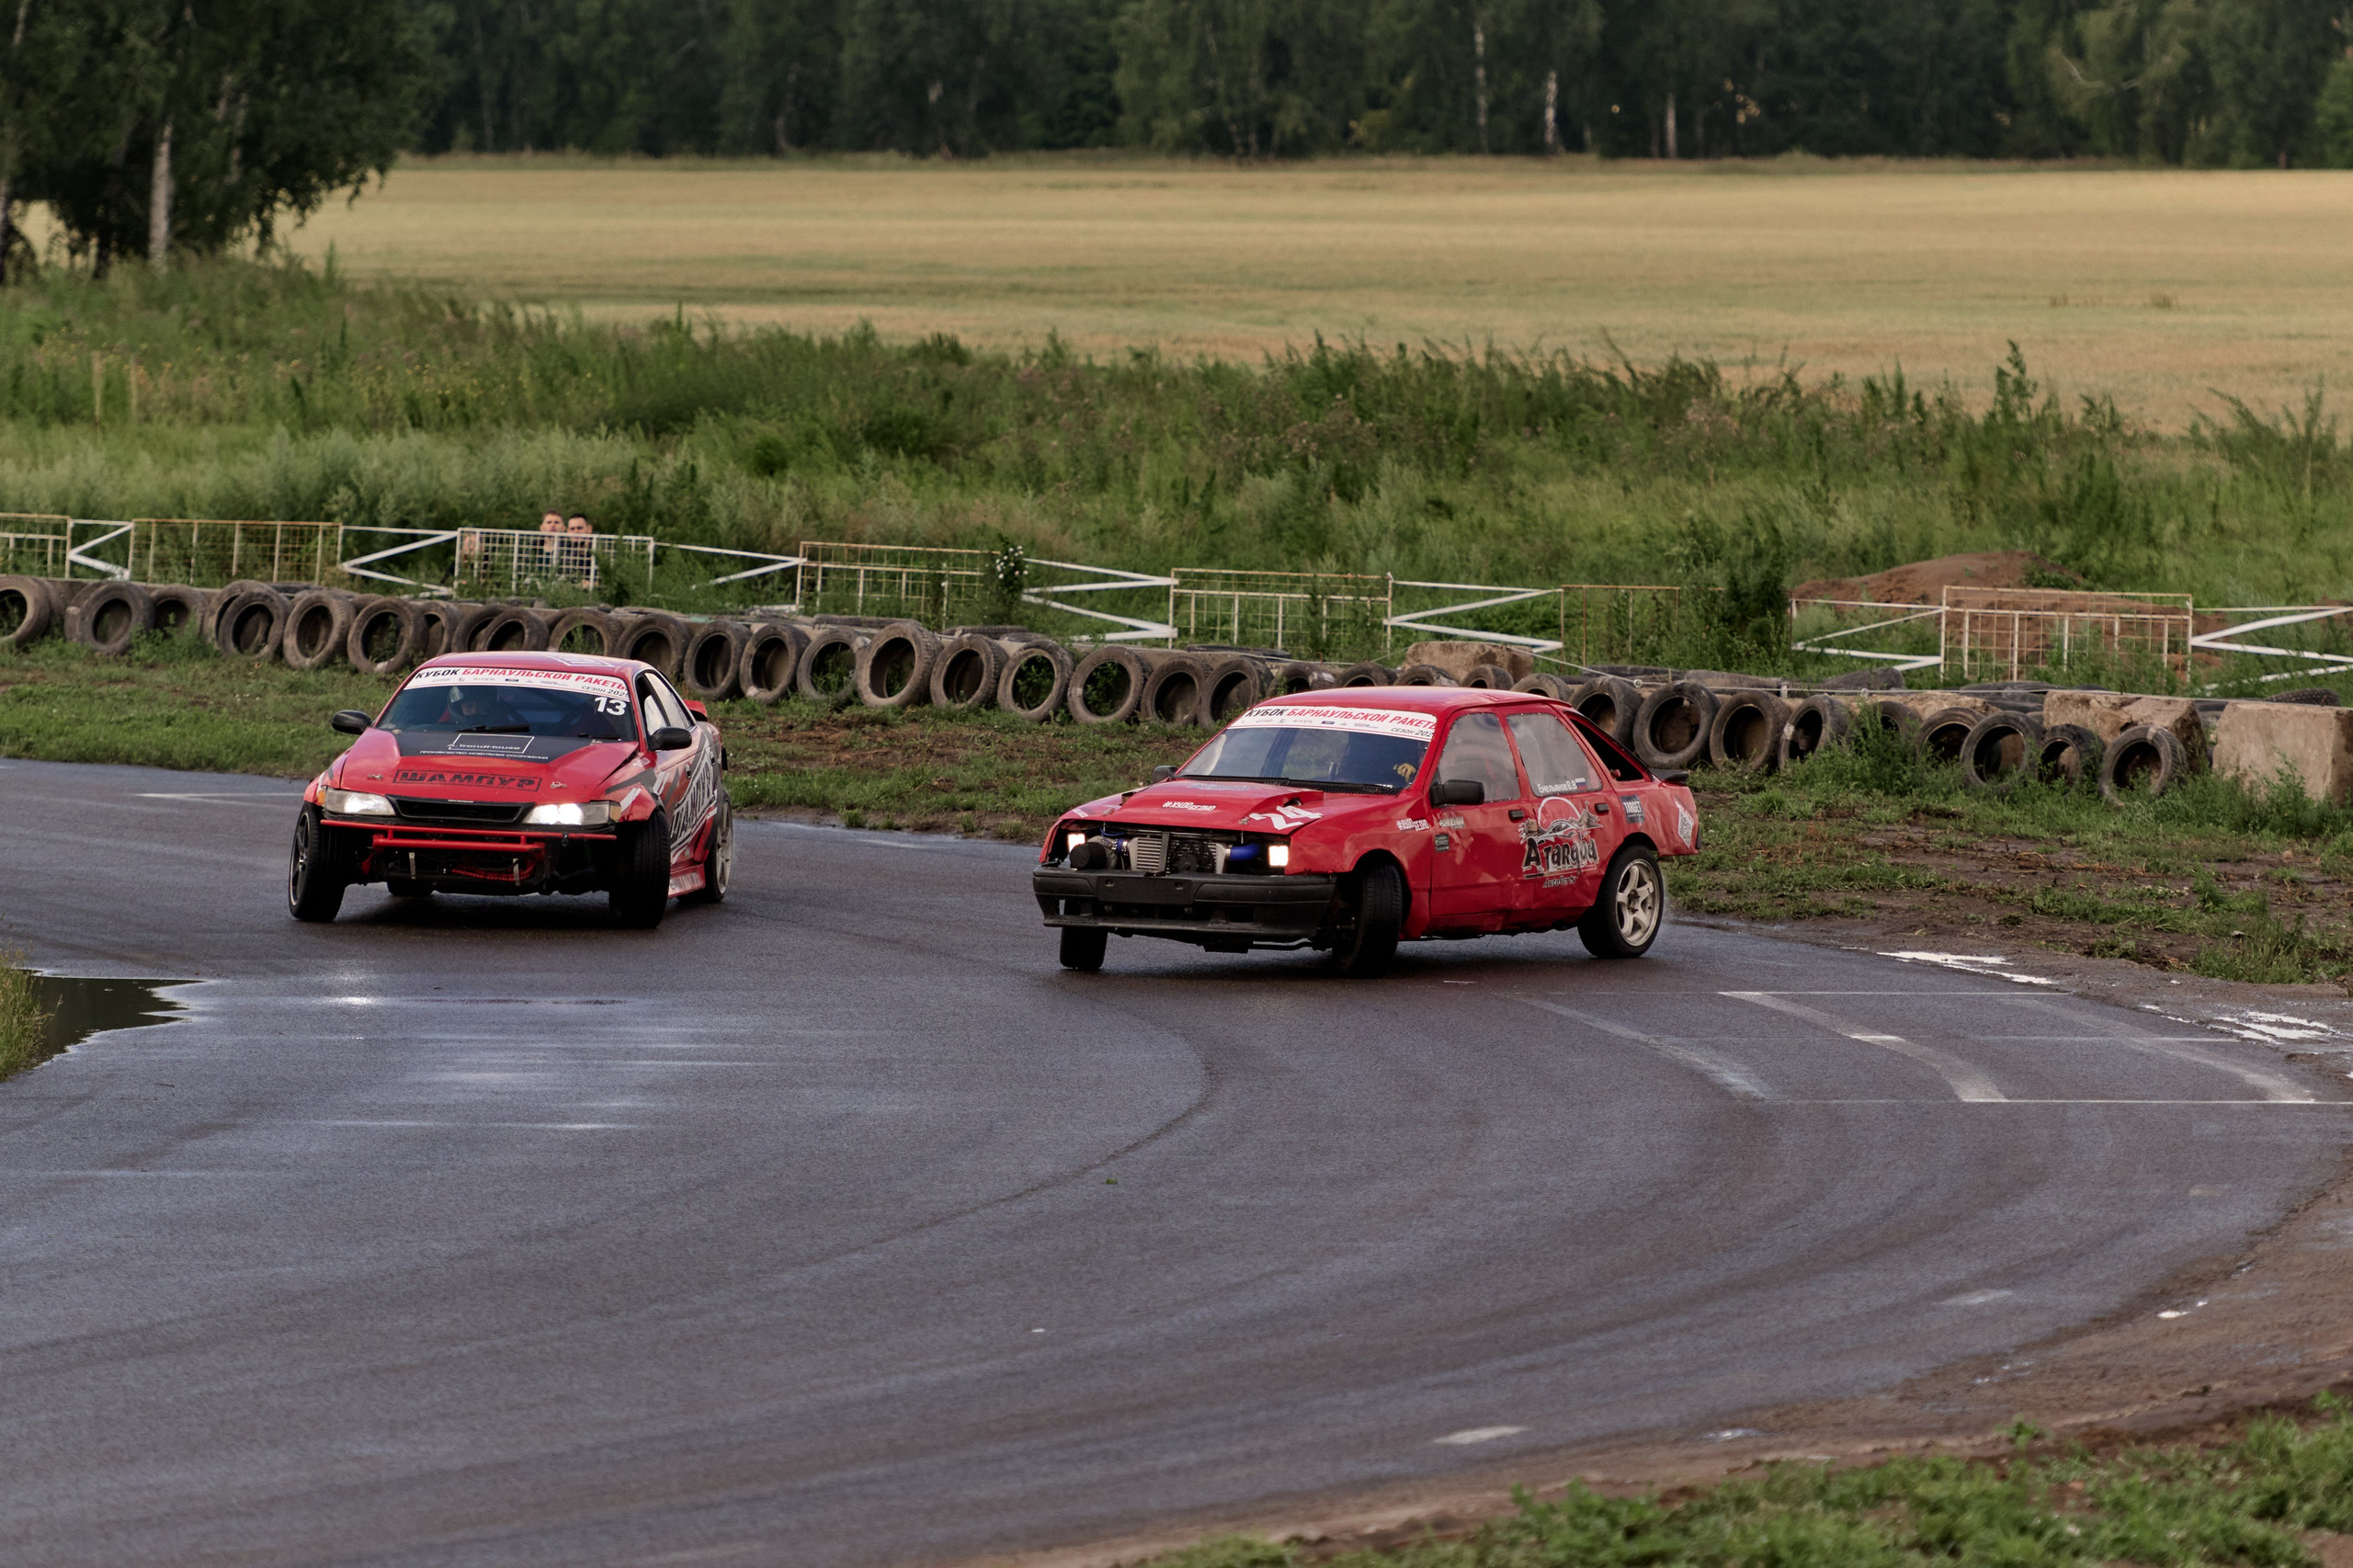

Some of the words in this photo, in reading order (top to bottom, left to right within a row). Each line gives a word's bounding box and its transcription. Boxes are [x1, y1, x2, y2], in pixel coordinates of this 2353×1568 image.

[415, 669, 460, 679] КУБОК
[461, 669, 572, 681] БАРНАУЛЬСКОЙ
[582, 685, 607, 693] СЕЗОН
[594, 696, 627, 716] 13
[1245, 708, 1289, 717] КУБОК
[1287, 708, 1391, 722] БАРНАУЛЬСКОЙ
[1415, 729, 1435, 738] 202
[399, 771, 536, 789] ШАМПУР
[1622, 801, 1642, 813] TARGET
[1248, 805, 1324, 830] 24
